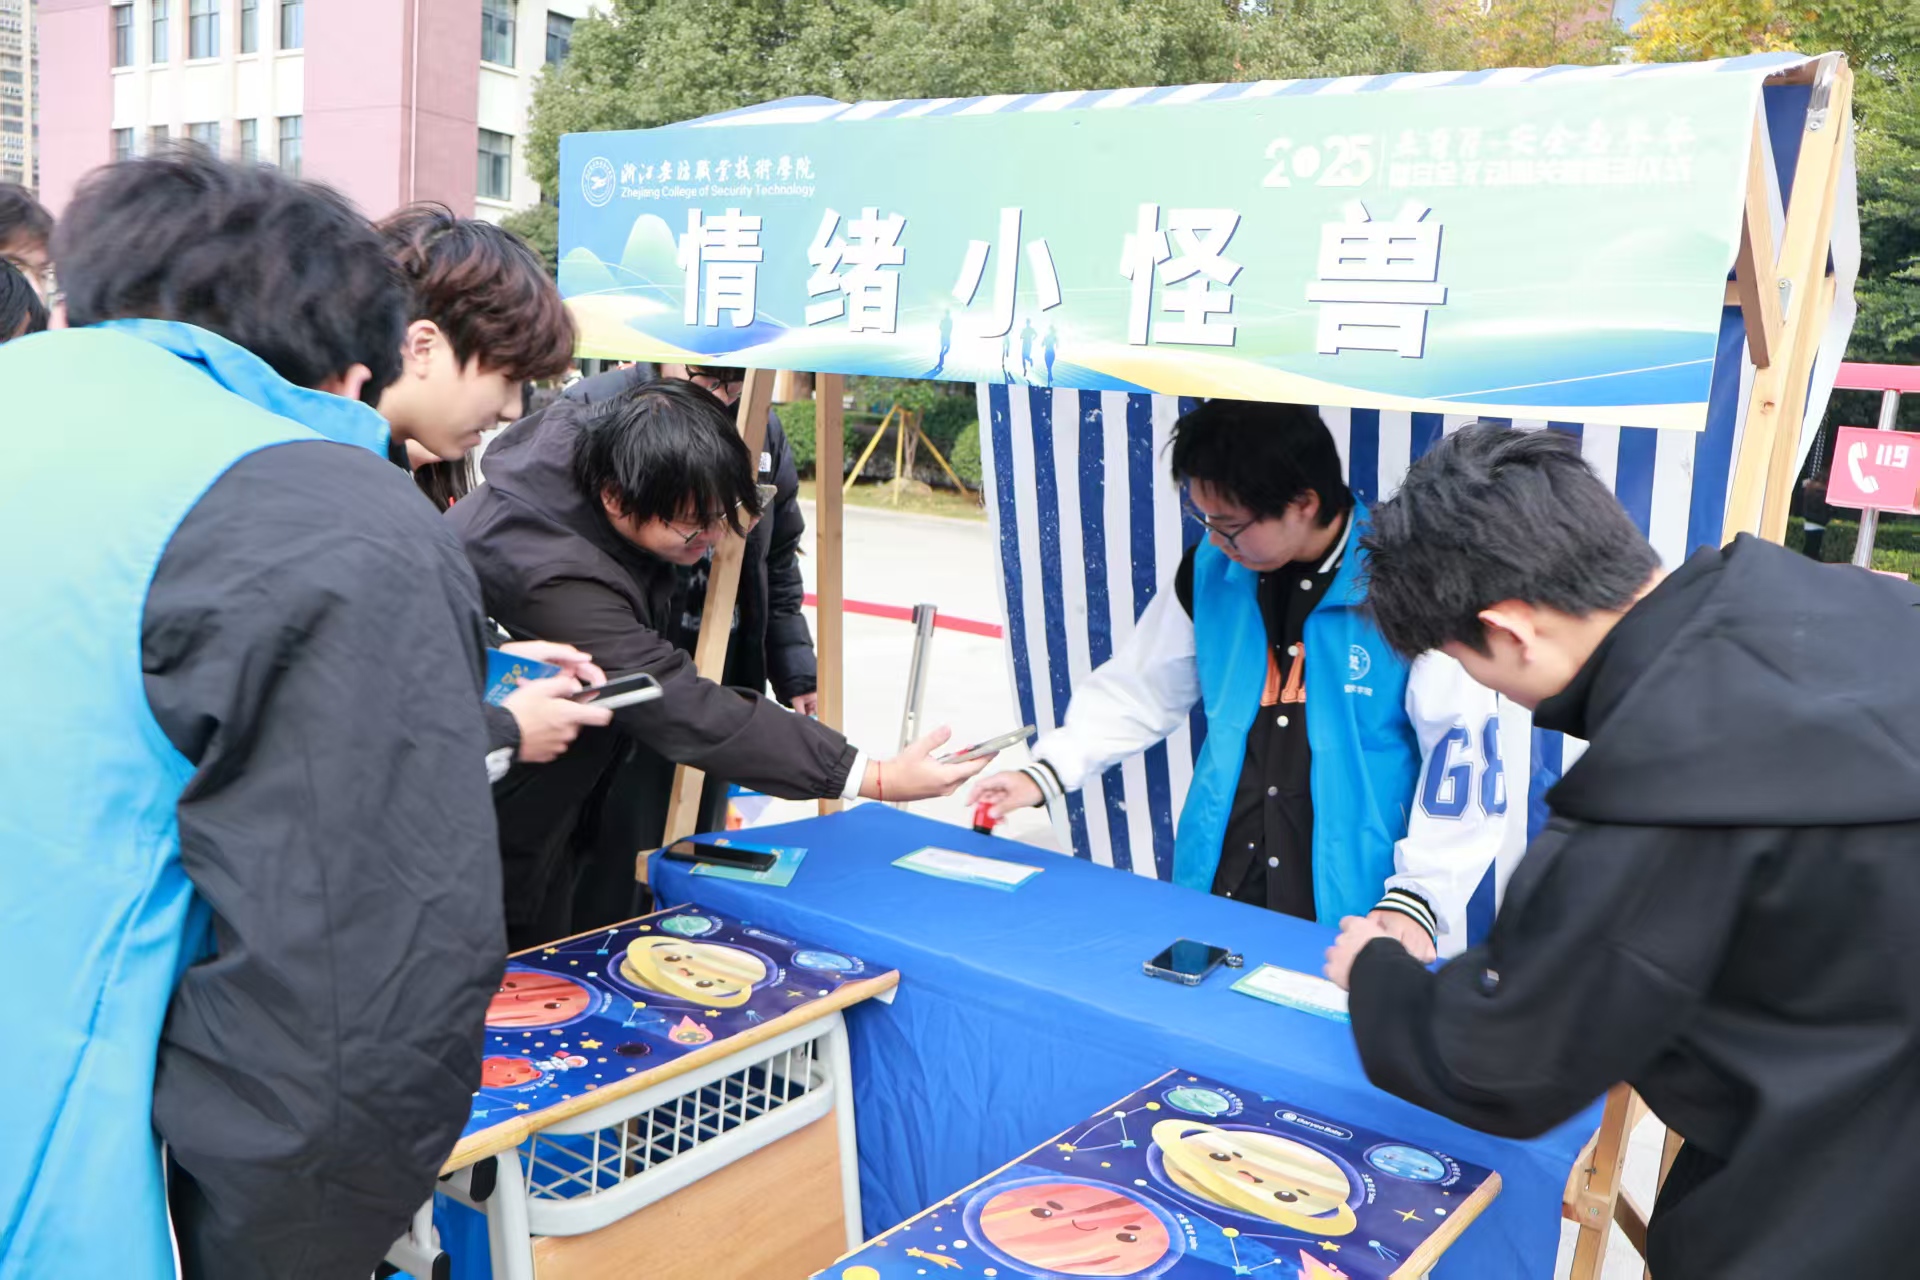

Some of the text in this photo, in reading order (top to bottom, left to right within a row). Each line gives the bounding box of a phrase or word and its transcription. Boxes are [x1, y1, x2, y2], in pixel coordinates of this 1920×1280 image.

[1262, 132, 1375, 187] 2025
[620, 183, 815, 200] Zhejiang College of Security Technology
[678, 201, 1448, 359] 情绪小怪兽
[1875, 444, 1910, 469] 119
[1419, 712, 1508, 820] 68
